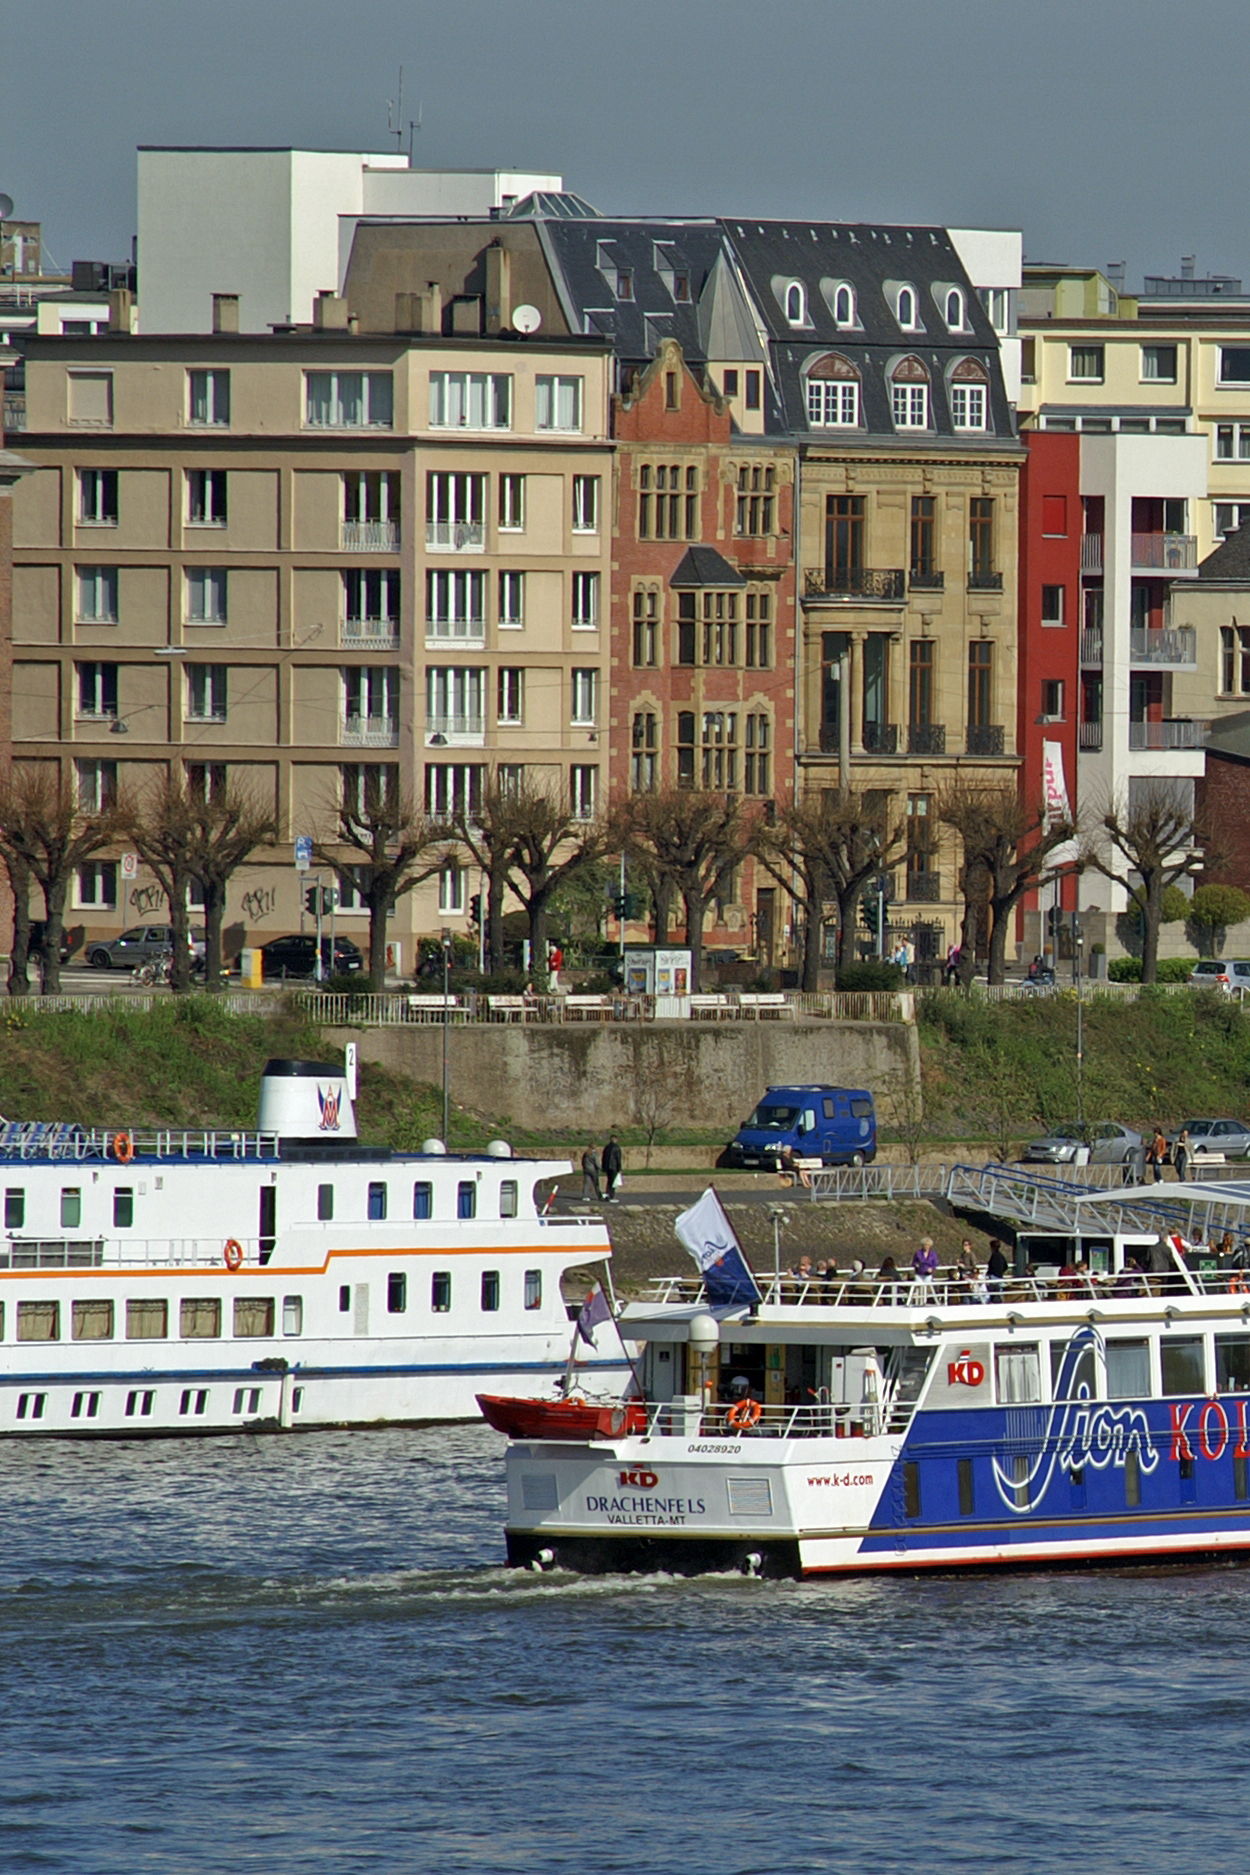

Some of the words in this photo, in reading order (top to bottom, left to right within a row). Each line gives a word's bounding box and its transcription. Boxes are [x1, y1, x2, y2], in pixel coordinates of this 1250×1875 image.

[348, 1047, 355, 1067] 2
[947, 1360, 985, 1387] KD
[992, 1324, 1160, 1513] Sion
[687, 1444, 742, 1455] 04028920
[619, 1470, 659, 1488] KD
[806, 1473, 874, 1488] www.k-d.com
[586, 1496, 706, 1515] DRACHENFELS
[606, 1513, 686, 1526] VALLETTA-MT
